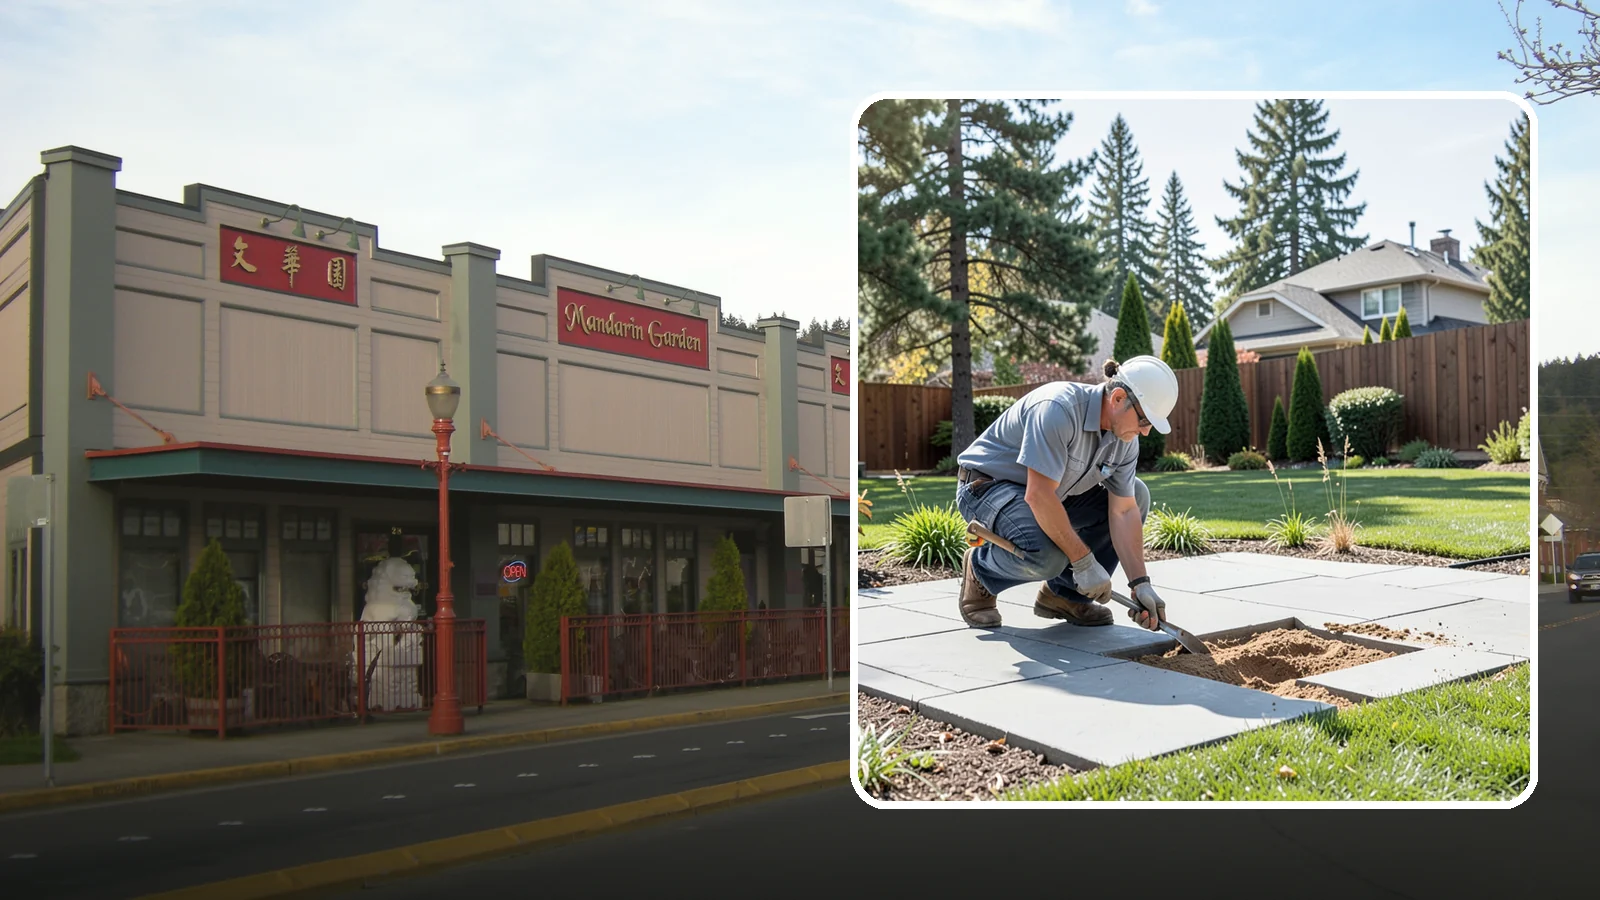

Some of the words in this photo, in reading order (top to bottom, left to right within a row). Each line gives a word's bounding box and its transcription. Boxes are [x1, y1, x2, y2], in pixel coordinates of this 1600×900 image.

[231, 235, 346, 291] 文華園
[564, 302, 644, 341] Mandarin
[647, 320, 702, 352] Garden
[503, 565, 527, 578] OPEN
